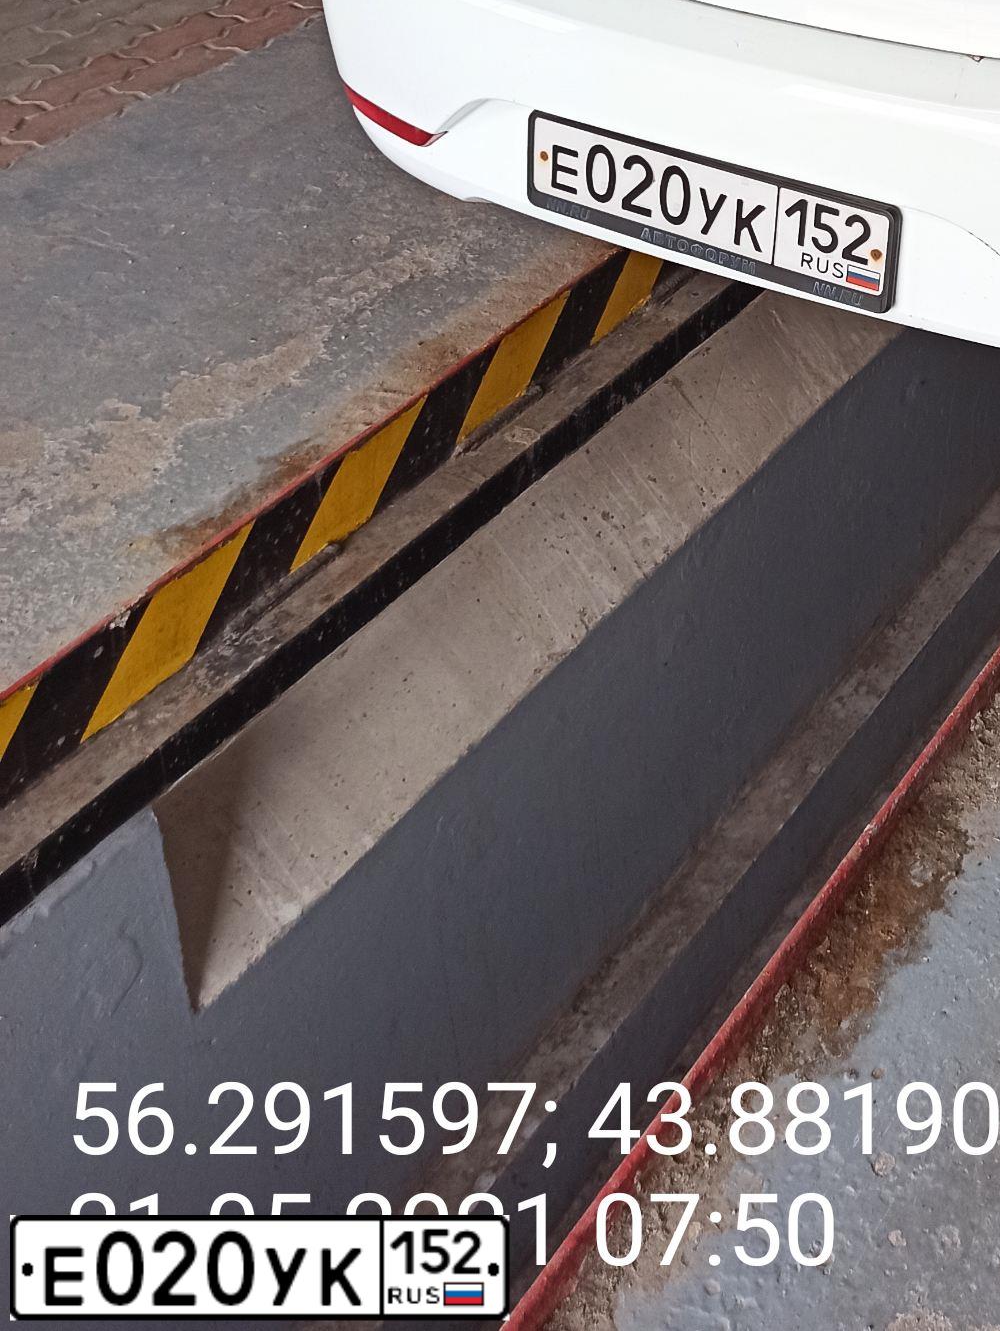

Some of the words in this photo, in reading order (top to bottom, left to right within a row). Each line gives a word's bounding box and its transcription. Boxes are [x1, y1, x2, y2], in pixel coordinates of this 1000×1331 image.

[550, 143, 766, 253] Е020УК
[784, 198, 871, 266] 152
[800, 252, 844, 279] RUS
